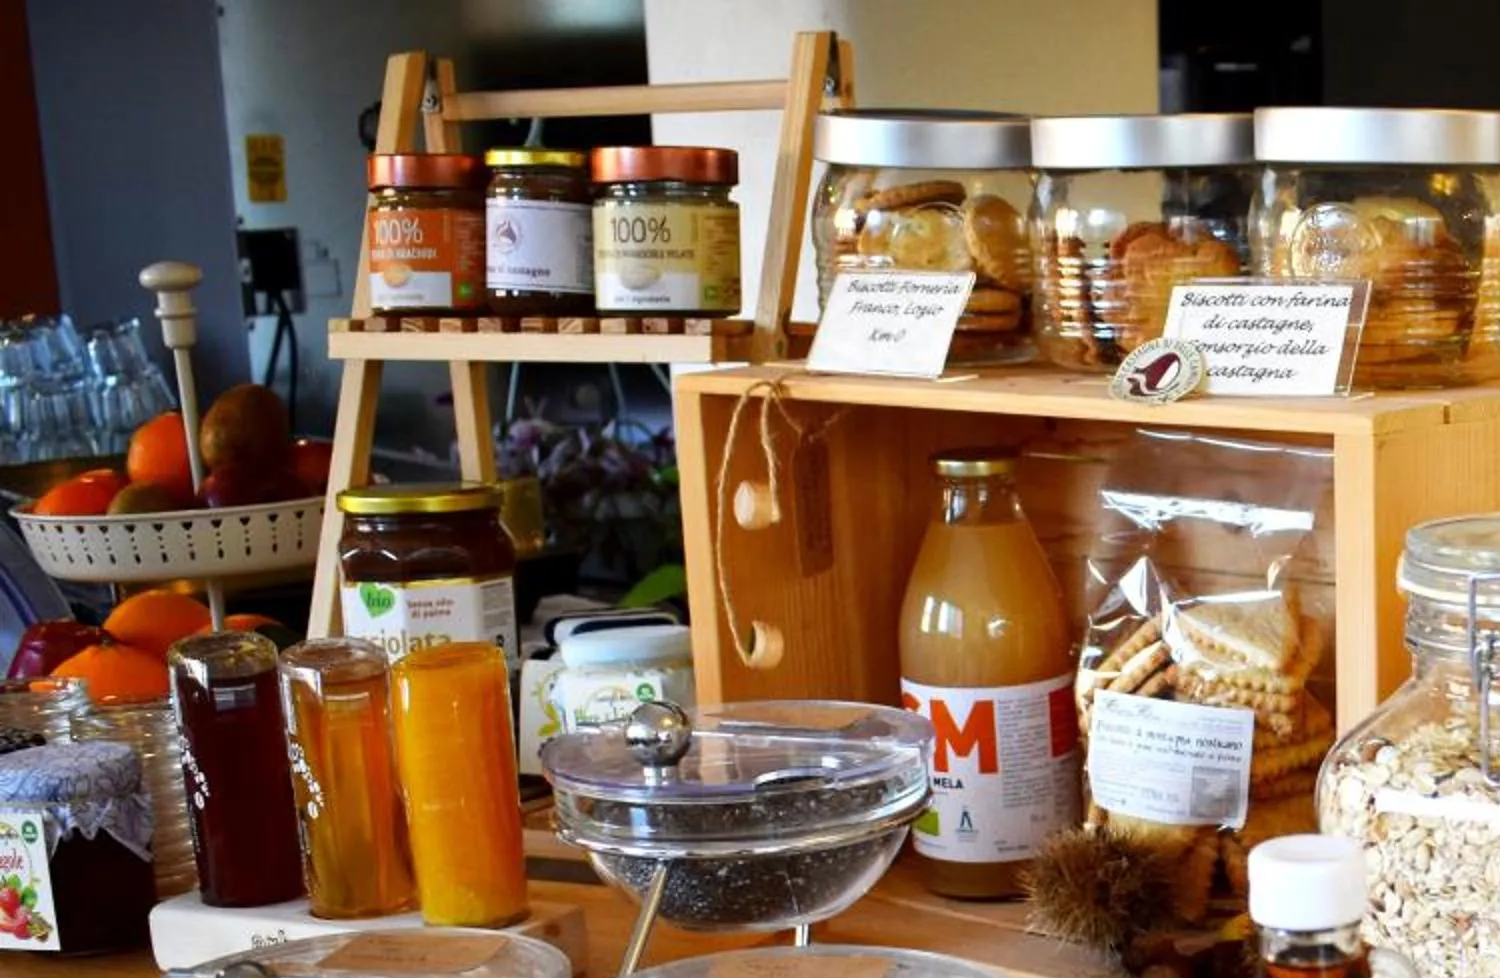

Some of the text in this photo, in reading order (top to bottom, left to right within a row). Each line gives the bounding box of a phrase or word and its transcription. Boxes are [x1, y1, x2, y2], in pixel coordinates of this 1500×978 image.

[374, 217, 423, 245] 100%
[610, 215, 671, 243] 100%
[1181, 291, 1352, 308] Biscotti con farina
[1203, 314, 1224, 329] di
[1277, 339, 1328, 356] della
[1206, 364, 1296, 383] castagna
[933, 776, 965, 790] MELA
